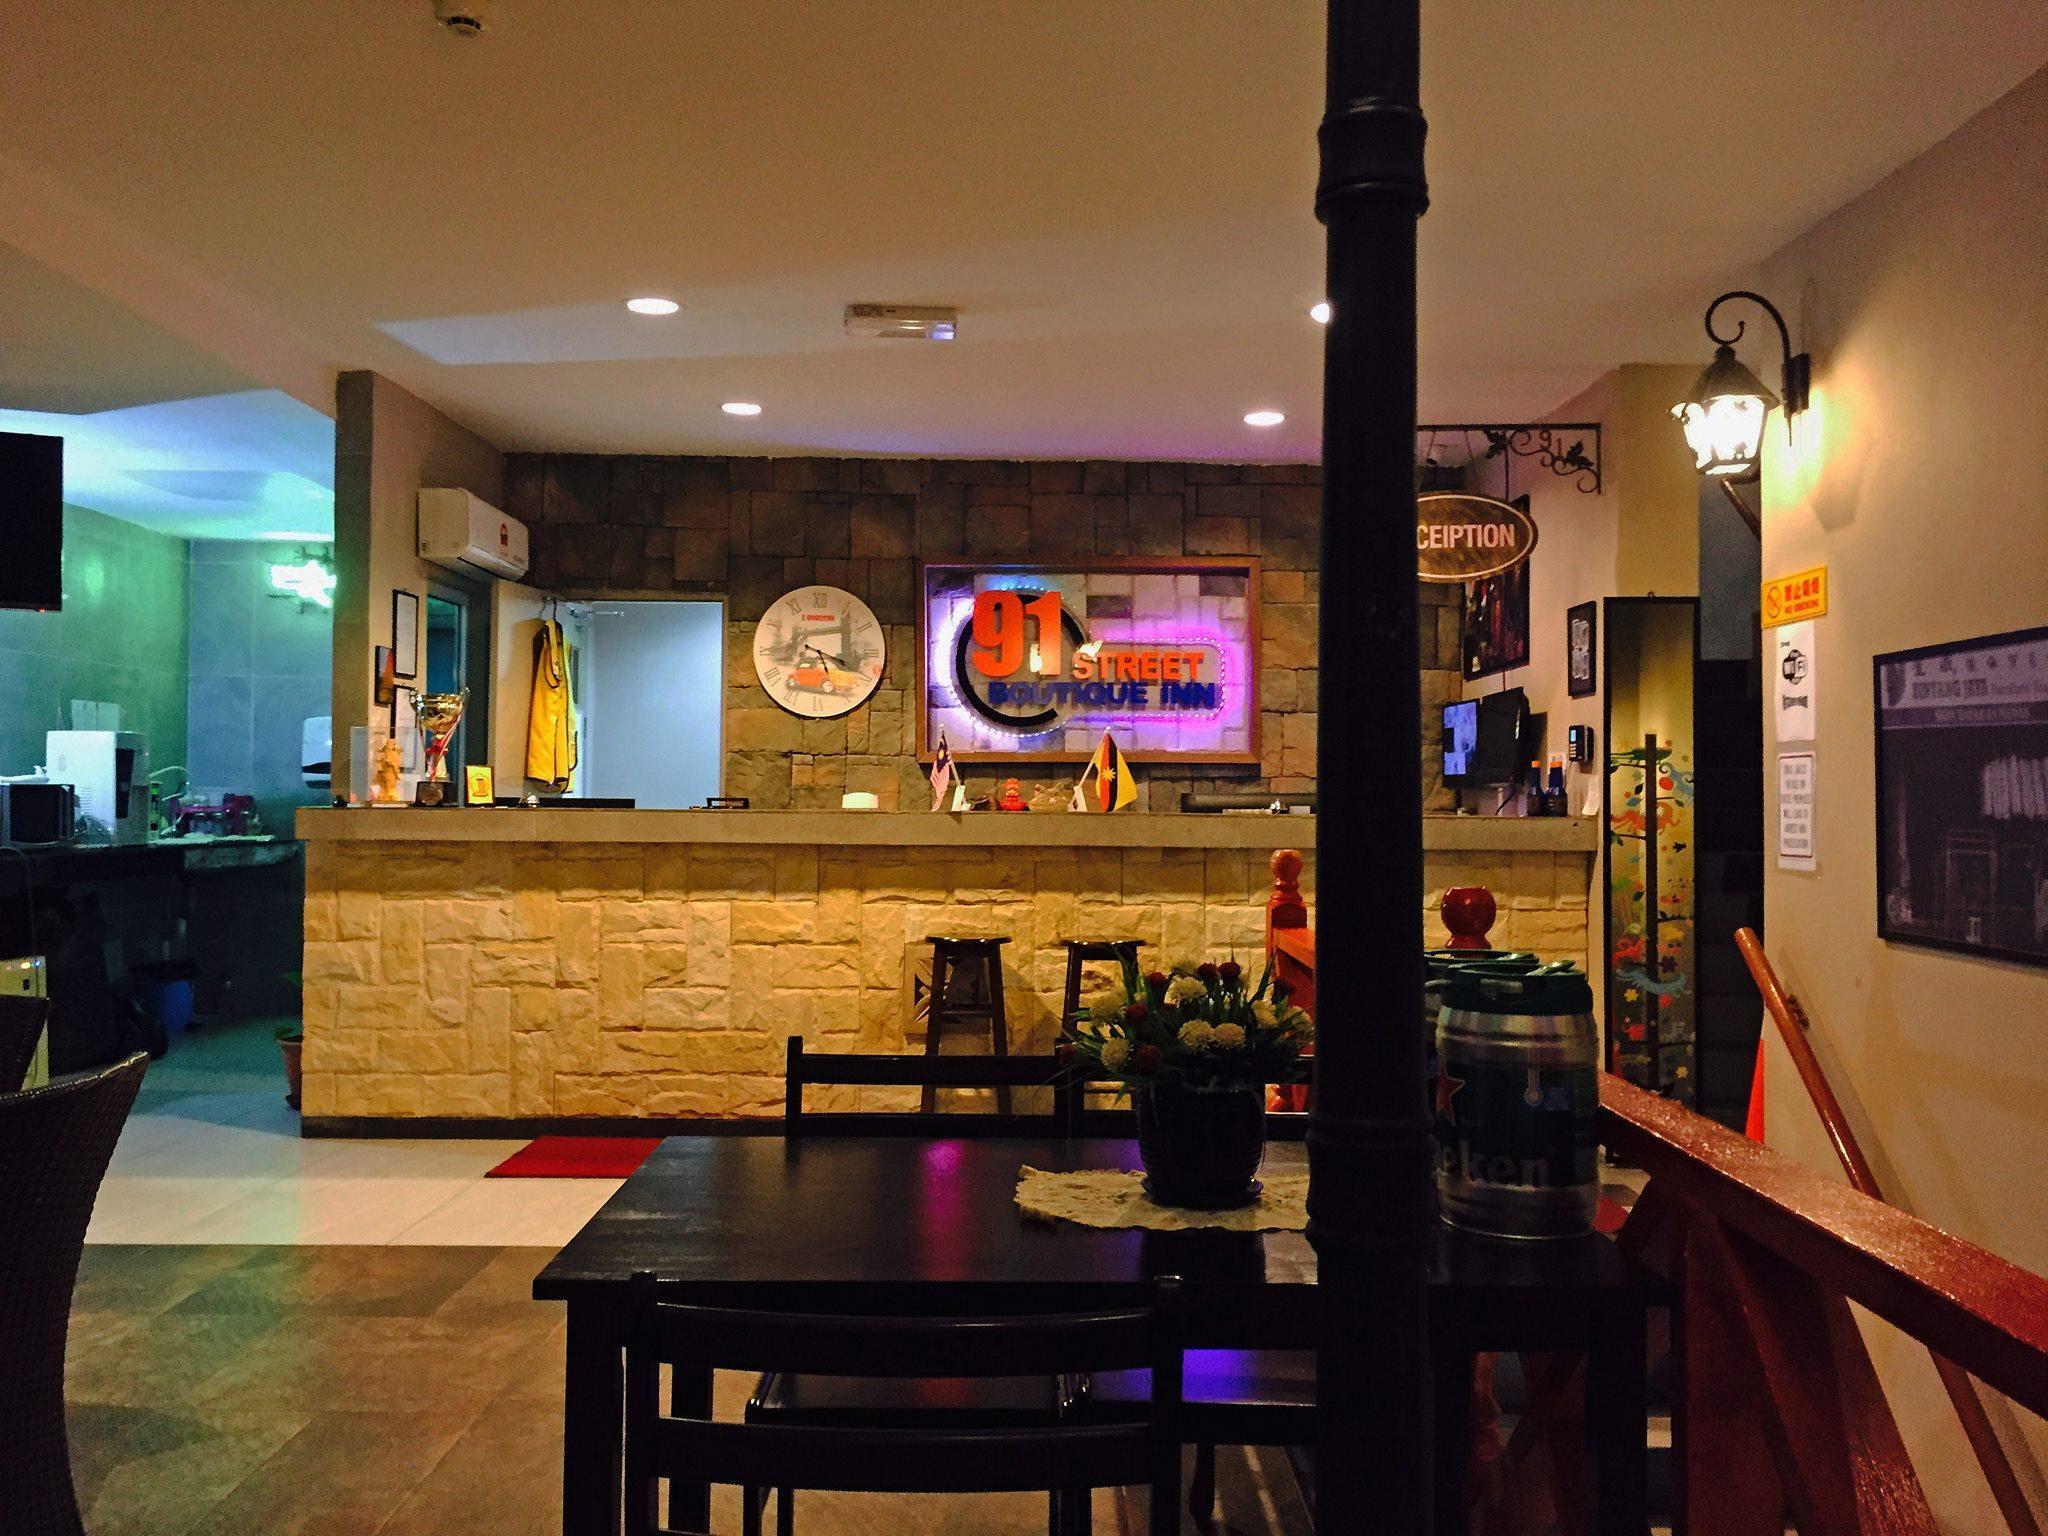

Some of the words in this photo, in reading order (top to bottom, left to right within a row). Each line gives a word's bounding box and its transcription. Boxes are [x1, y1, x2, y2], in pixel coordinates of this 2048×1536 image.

[1416, 523, 1515, 550] CEIPTION
[972, 590, 1062, 677] 91
[1072, 652, 1205, 681] STREET
[988, 681, 1149, 706] BOUTIQUE
[1159, 681, 1216, 709] INN
